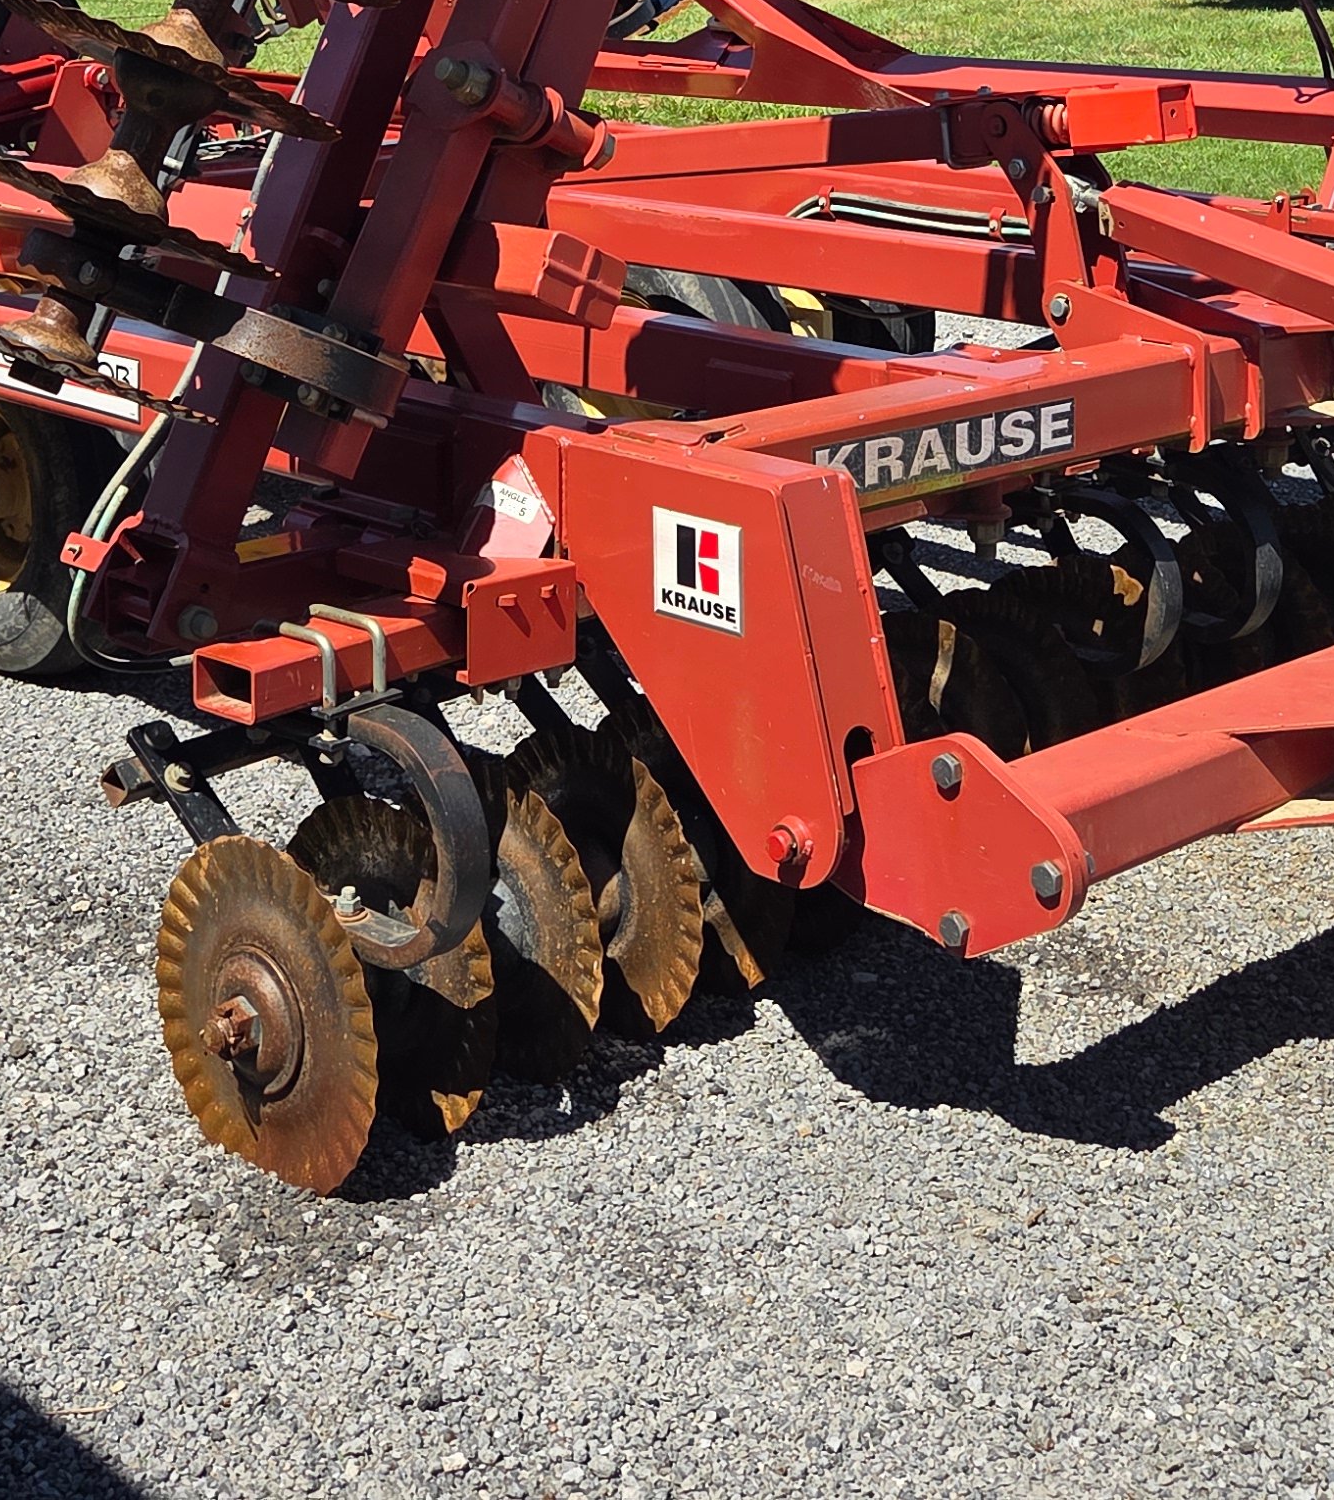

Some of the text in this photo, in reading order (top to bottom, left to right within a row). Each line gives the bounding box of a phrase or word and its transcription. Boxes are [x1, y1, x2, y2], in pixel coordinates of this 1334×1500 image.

[815, 401, 1073, 488] KRAUSE
[499, 488, 528, 505] ANGLE
[661, 588, 736, 624] KRAUSE
